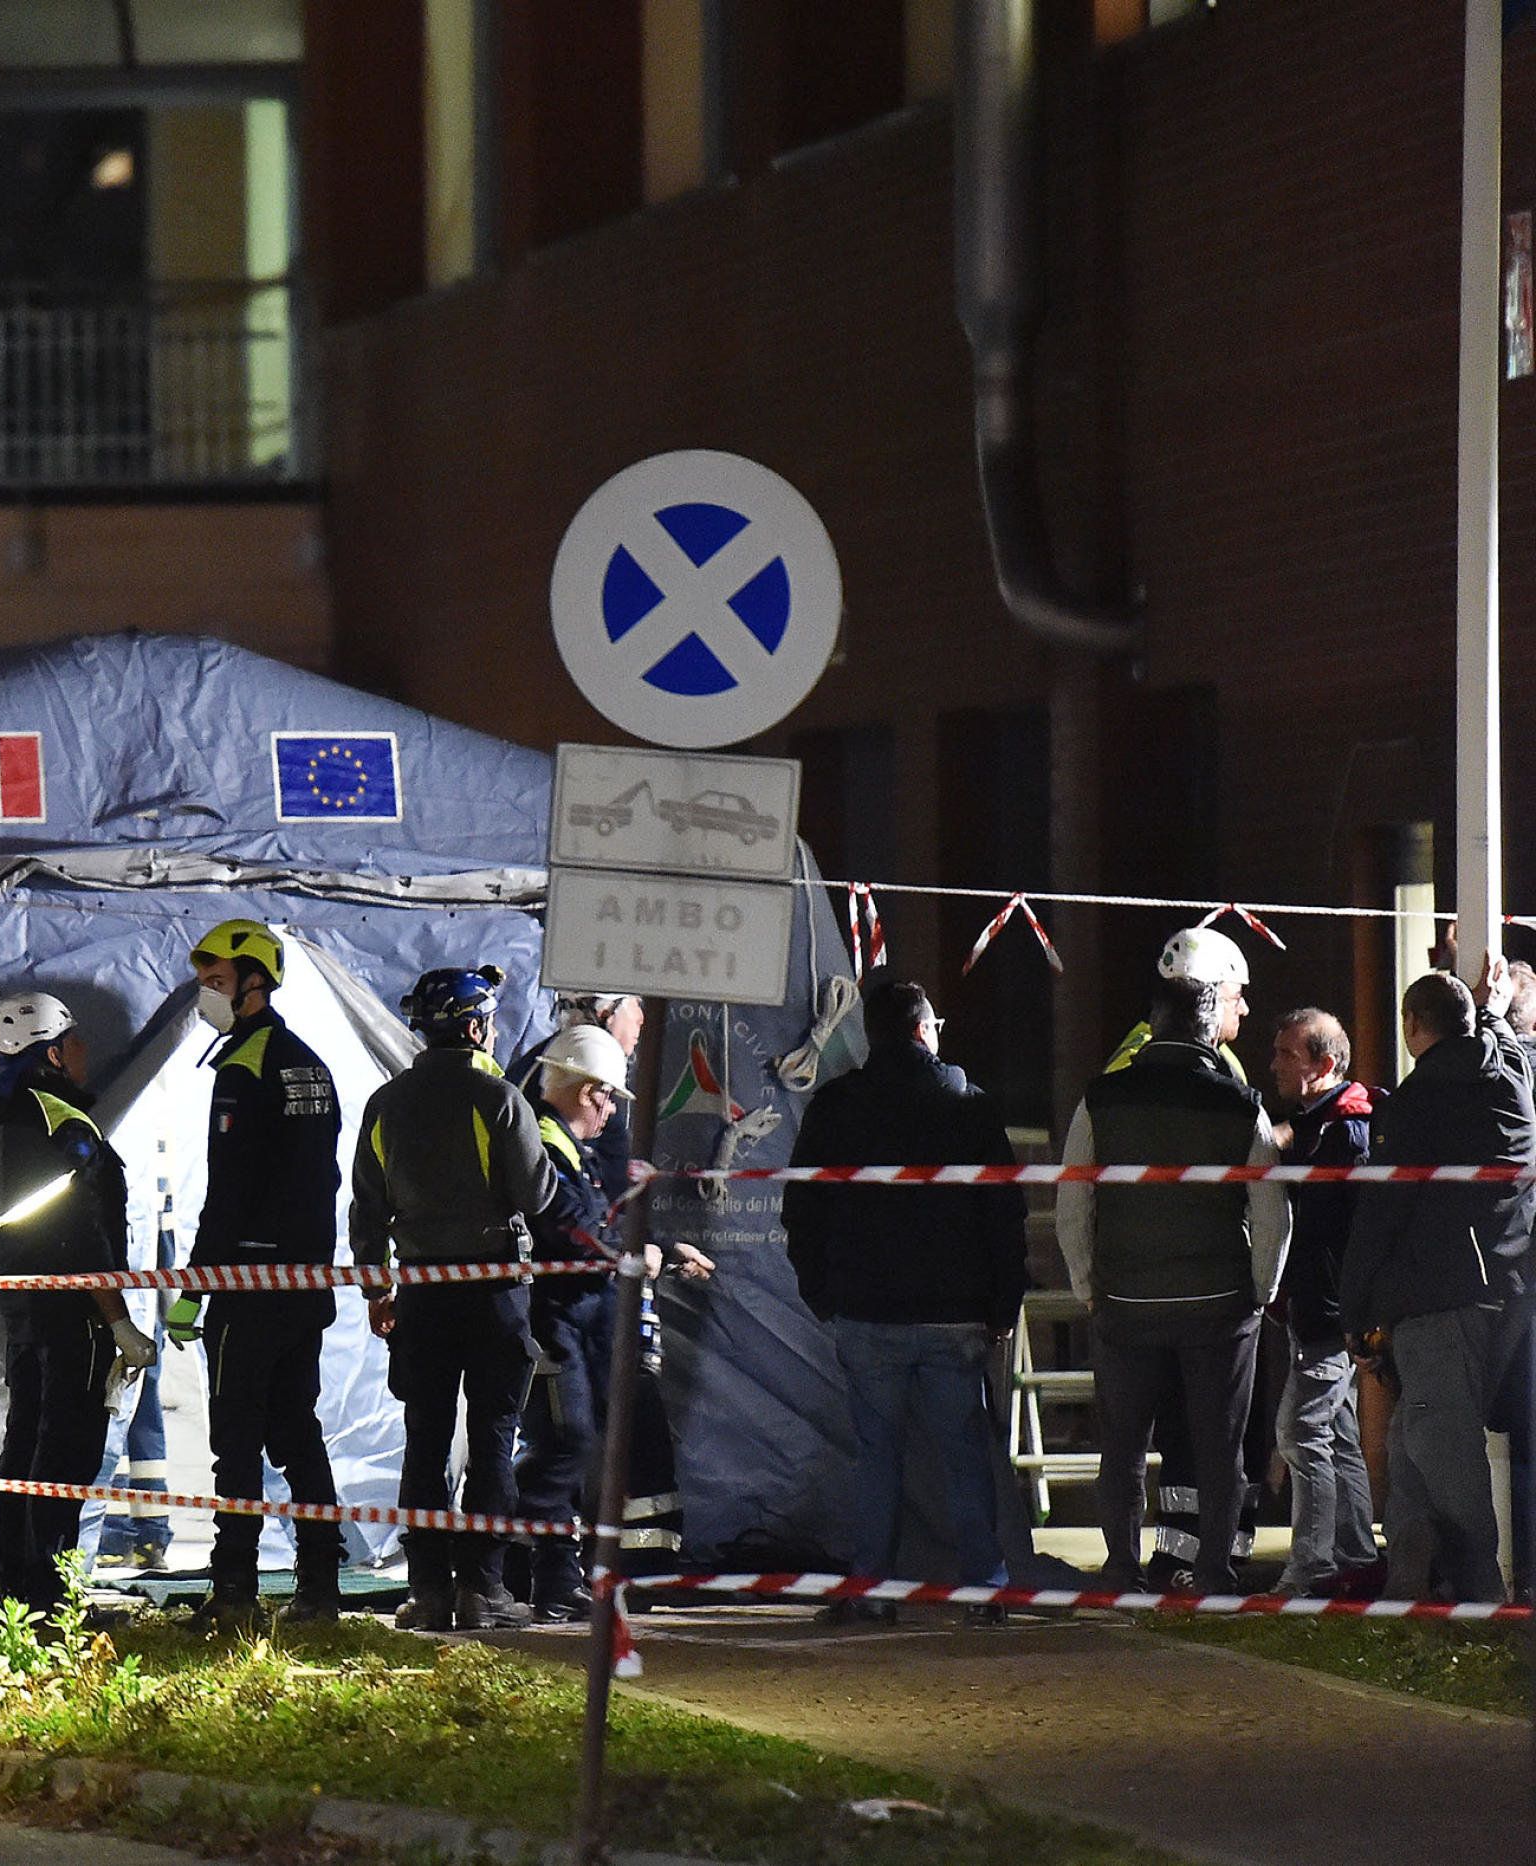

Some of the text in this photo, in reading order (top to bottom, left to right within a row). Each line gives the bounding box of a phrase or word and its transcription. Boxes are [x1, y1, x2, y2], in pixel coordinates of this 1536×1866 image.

[595, 896, 742, 931] AMBO
[595, 941, 737, 979] I LATI
